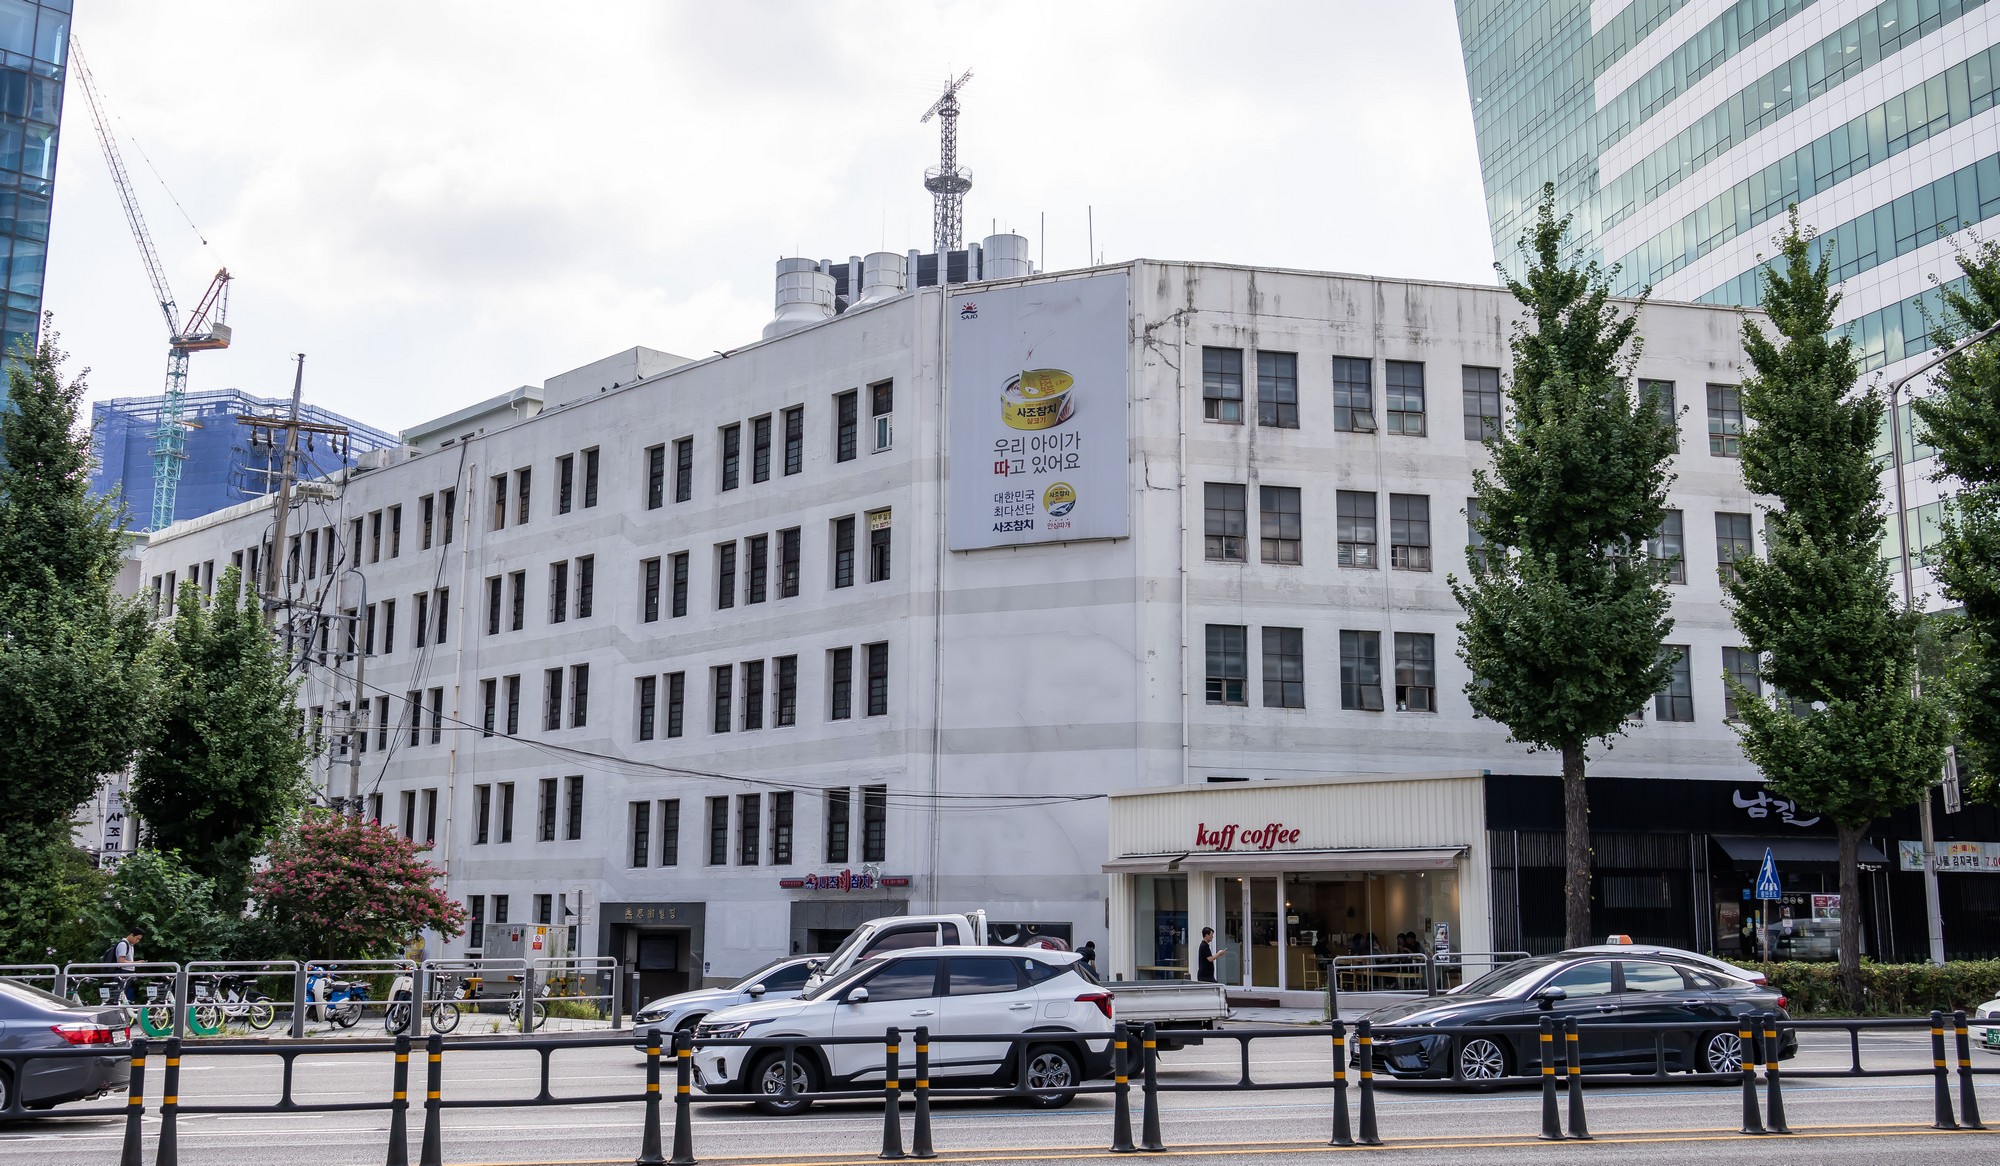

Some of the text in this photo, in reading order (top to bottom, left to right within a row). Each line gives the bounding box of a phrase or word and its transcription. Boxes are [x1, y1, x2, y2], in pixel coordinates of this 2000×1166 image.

[1017, 403, 1057, 418] 사조참치
[994, 431, 1081, 457] 우리 아이가
[994, 453, 1080, 477] 따고 있어요
[994, 490, 1035, 504] 대한민국
[994, 503, 1035, 517] 최다선단
[992, 519, 1034, 533] 사조참치
[1196, 823, 1301, 851] kaff coffee
[1936, 855, 1950, 867] 나물
[1985, 856, 2000, 867] 7.0
